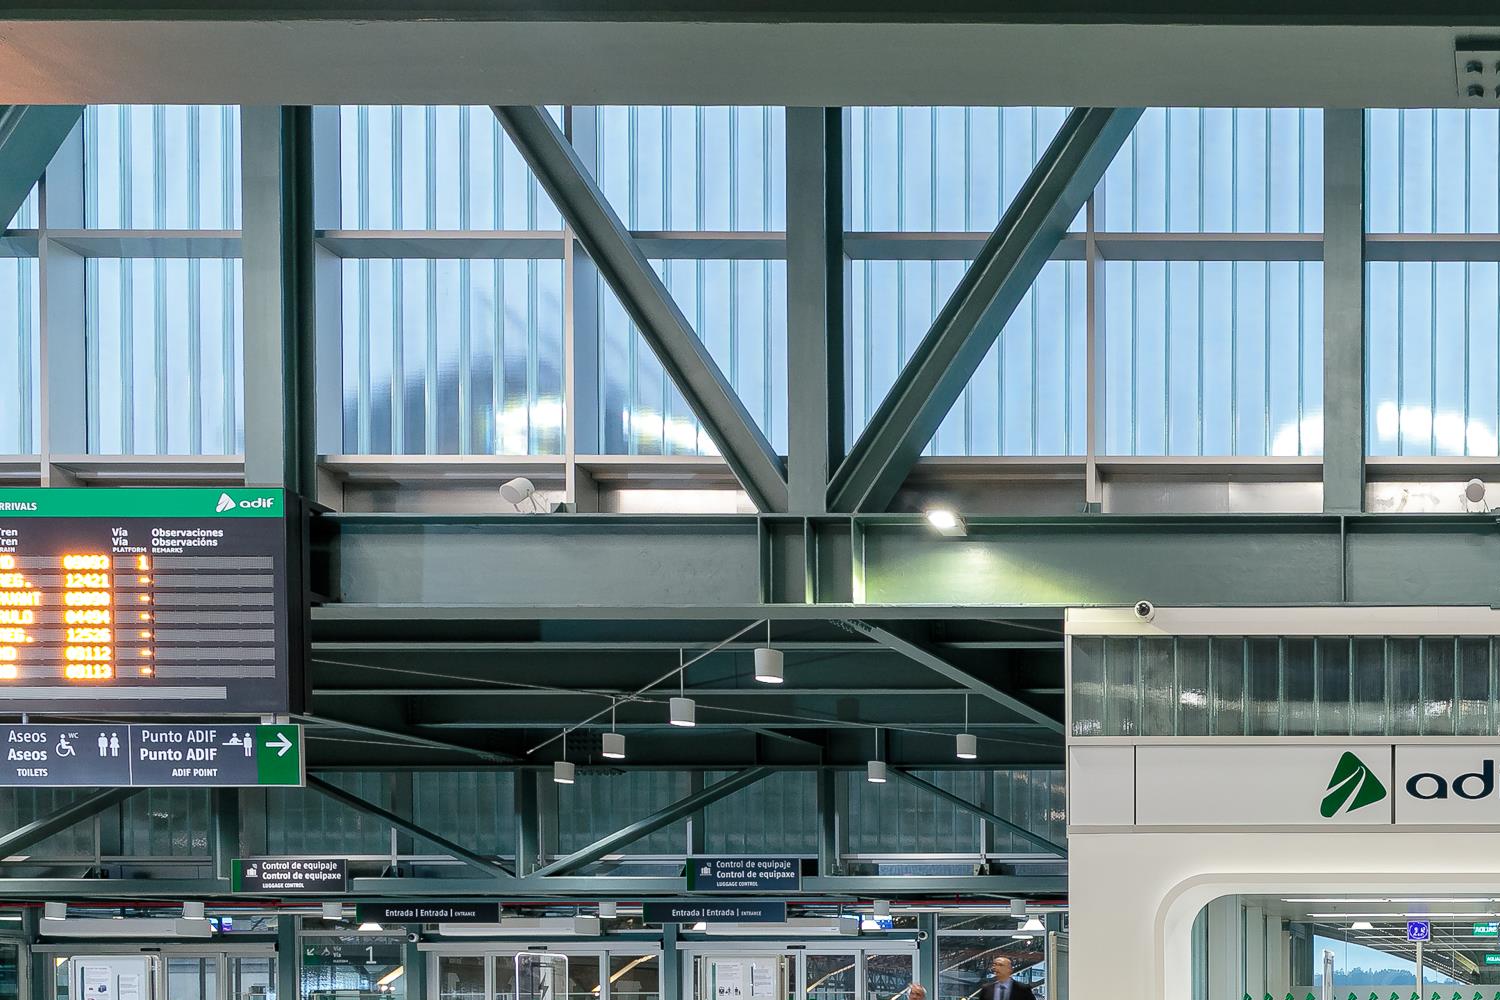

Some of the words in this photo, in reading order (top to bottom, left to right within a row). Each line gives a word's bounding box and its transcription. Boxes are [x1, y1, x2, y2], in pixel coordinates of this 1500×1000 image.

[239, 498, 274, 509] adif
[112, 527, 128, 536] Vía
[151, 528, 224, 537] Observaciones
[112, 536, 128, 546] Vía
[151, 537, 218, 547] Observacións
[138, 554, 149, 570] 1
[8, 729, 47, 743] Aseos
[141, 729, 183, 743] Punto
[187, 729, 217, 743] ADIF
[7, 748, 48, 761] Aseos
[140, 748, 182, 761] Punto
[186, 747, 218, 761] ADIF
[16, 768, 48, 777] TOILETS
[171, 768, 190, 777] ADIF
[193, 768, 218, 777] POINT
[261, 861, 290, 870] Control
[291, 861, 301, 870] de
[303, 861, 338, 871] equipaje
[716, 860, 744, 869] Control
[745, 860, 756, 869] de
[757, 861, 791, 870] equipaje
[262, 872, 291, 880] Control
[292, 872, 303, 880] de
[304, 872, 342, 881] equipaxe
[716, 871, 745, 879] Control
[746, 871, 757, 879] de
[758, 871, 795, 880] equipaxe
[385, 909, 414, 917] Entrada
[420, 909, 449, 917] Entrada
[671, 909, 700, 917] Entrada
[706, 909, 735, 917] Entrada
[365, 946, 377, 964] 1
